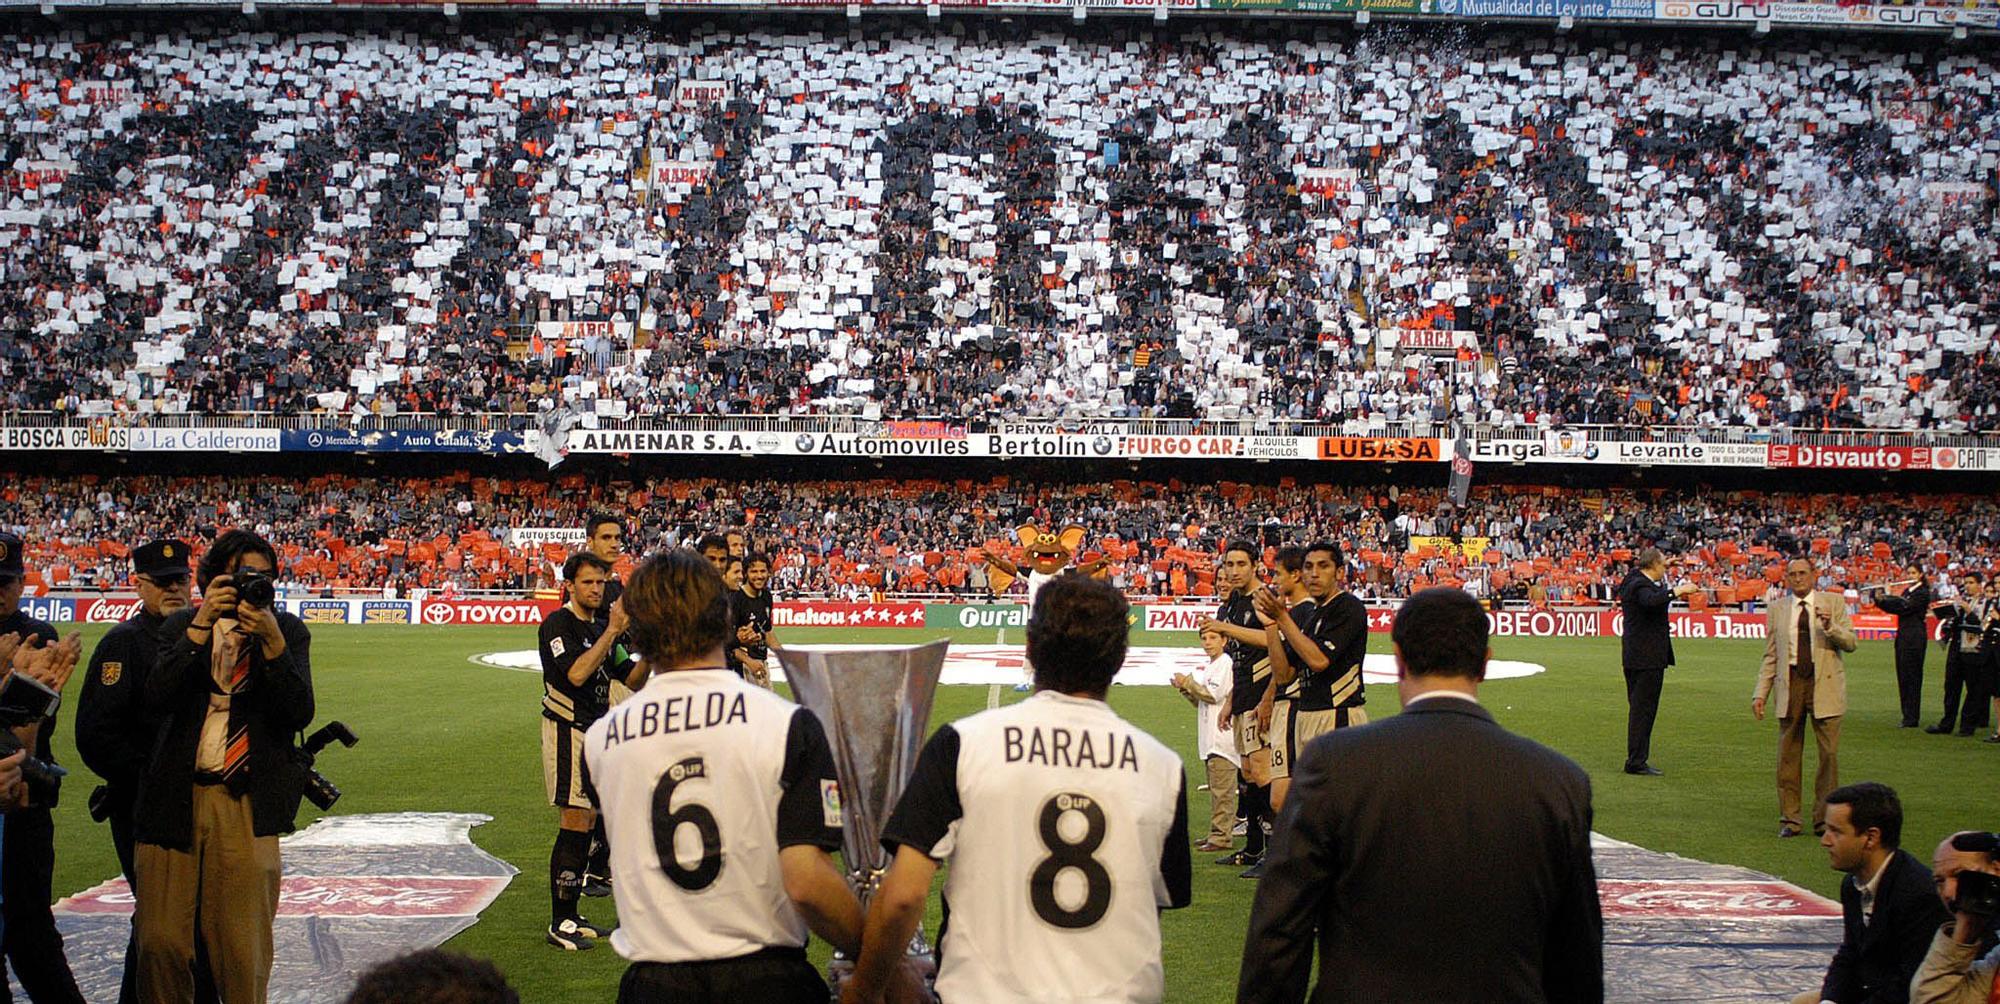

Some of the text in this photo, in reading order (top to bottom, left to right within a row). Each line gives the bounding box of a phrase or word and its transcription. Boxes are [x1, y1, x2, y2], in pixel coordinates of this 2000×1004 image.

[1462, 0, 1534, 15] Mutualidad
[1536, 0, 1552, 15] de
[563, 321, 615, 337] MARCA
[1400, 331, 1454, 347] MARCA
[9, 429, 64, 447] BOSCA
[1005, 425, 1054, 434] PENYA
[153, 433, 277, 449] La Calderona
[403, 436, 431, 446] Auto
[583, 434, 695, 450] ALMENAR
[820, 435, 1086, 455] Automoviles Bertolín
[1127, 438, 1233, 455] FURGO CAR
[1252, 438, 1298, 446] ALQUILER
[1324, 440, 1433, 459] LUBASA
[1247, 447, 1299, 456] VEHICULOS
[1620, 443, 1704, 458] Levante
[1797, 447, 1901, 468] Disvauto
[1958, 449, 1987, 469] CAM
[519, 531, 586, 540] AUTOESCUELA
[86, 598, 145, 624] Coca-C
[302, 608, 346, 623] SER
[364, 608, 408, 623] SER
[457, 605, 543, 622] TOYOTA
[772, 607, 846, 626] Mahou
[1556, 612, 1597, 637] 2004
[1712, 614, 1767, 638] Dam
[604, 692, 749, 750] ALBELDA
[1004, 726, 1140, 773] BARAJA
[650, 757, 724, 892] 6
[1028, 791, 1113, 929] 8
